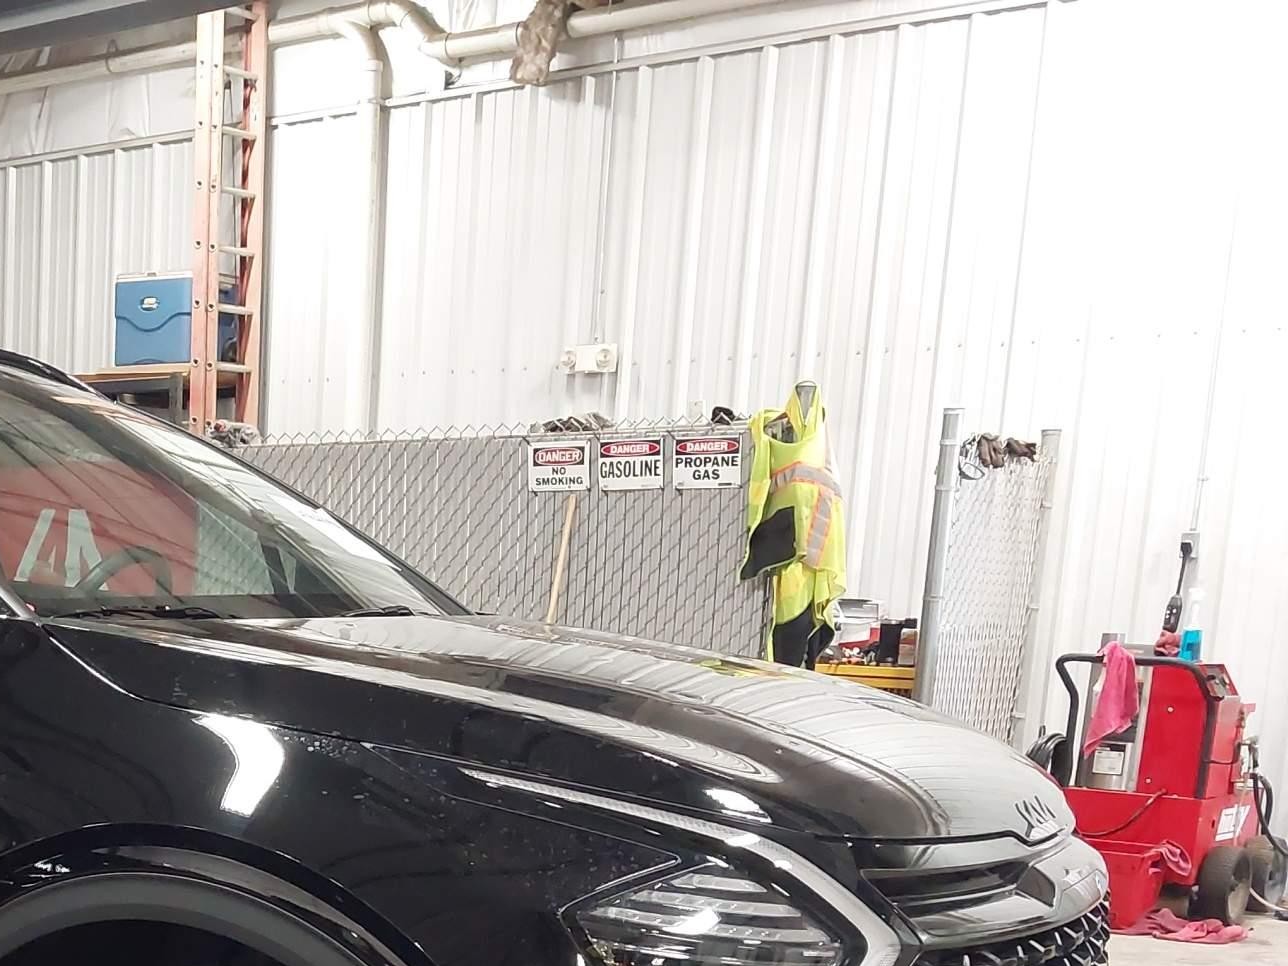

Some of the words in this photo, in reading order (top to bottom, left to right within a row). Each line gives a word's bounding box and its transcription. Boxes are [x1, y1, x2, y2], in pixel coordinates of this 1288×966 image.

[610, 444, 649, 454] DANGER
[686, 442, 728, 452] DANGER
[538, 450, 580, 462] DANGER
[675, 456, 739, 468] PROPANE
[551, 467, 567, 475] NO
[600, 459, 661, 479] GASOLINE
[692, 469, 720, 480] GAS
[535, 477, 583, 486] SMOKING
